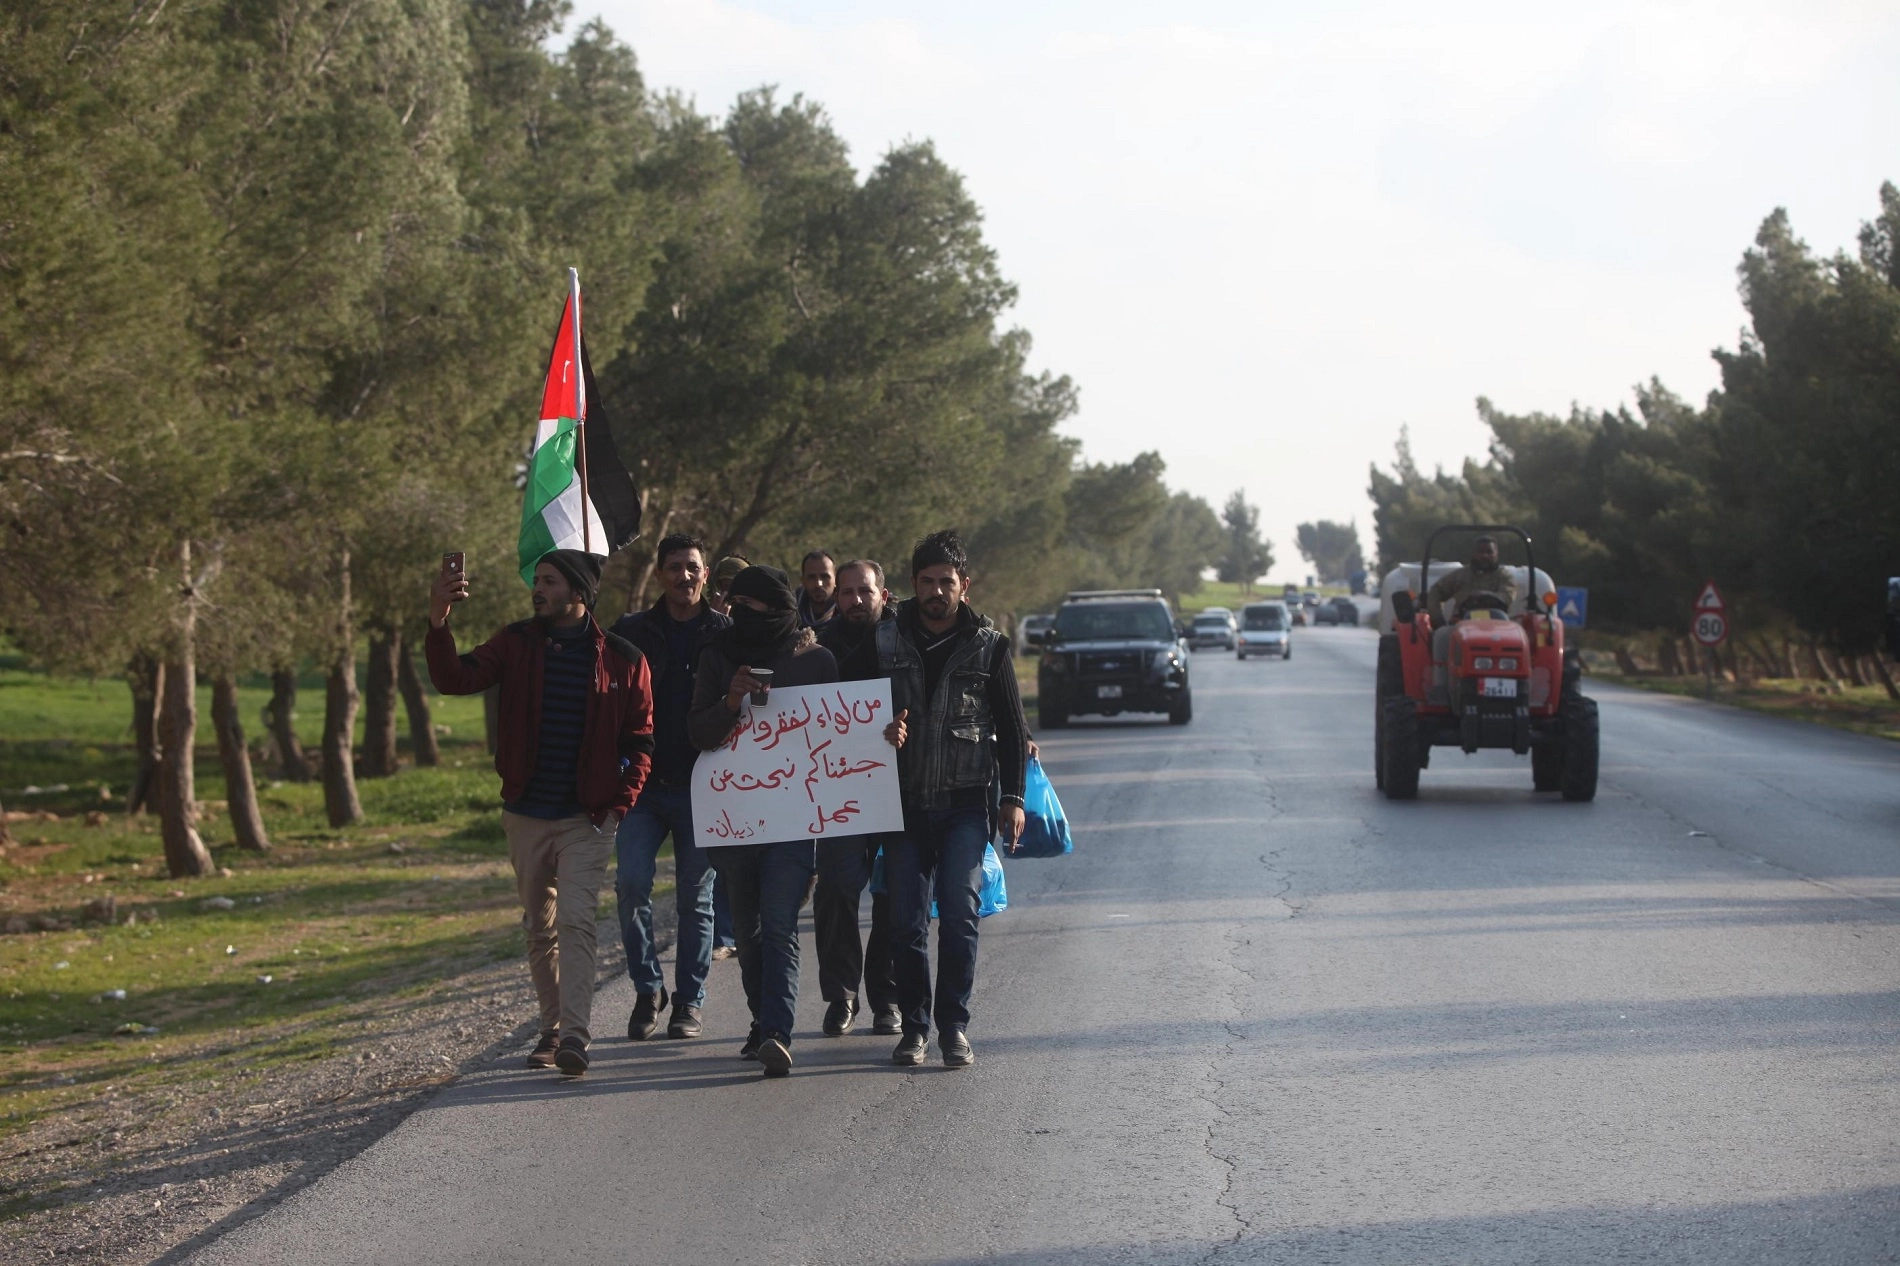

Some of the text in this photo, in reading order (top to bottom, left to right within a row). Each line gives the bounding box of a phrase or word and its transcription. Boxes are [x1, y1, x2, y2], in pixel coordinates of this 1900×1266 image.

[1699, 618, 1721, 637] 80
[816, 690, 851, 735] لواء
[853, 698, 881, 724] من
[710, 738, 887, 803] جئناكم نبحث عن
[808, 800, 860, 834] عمل
